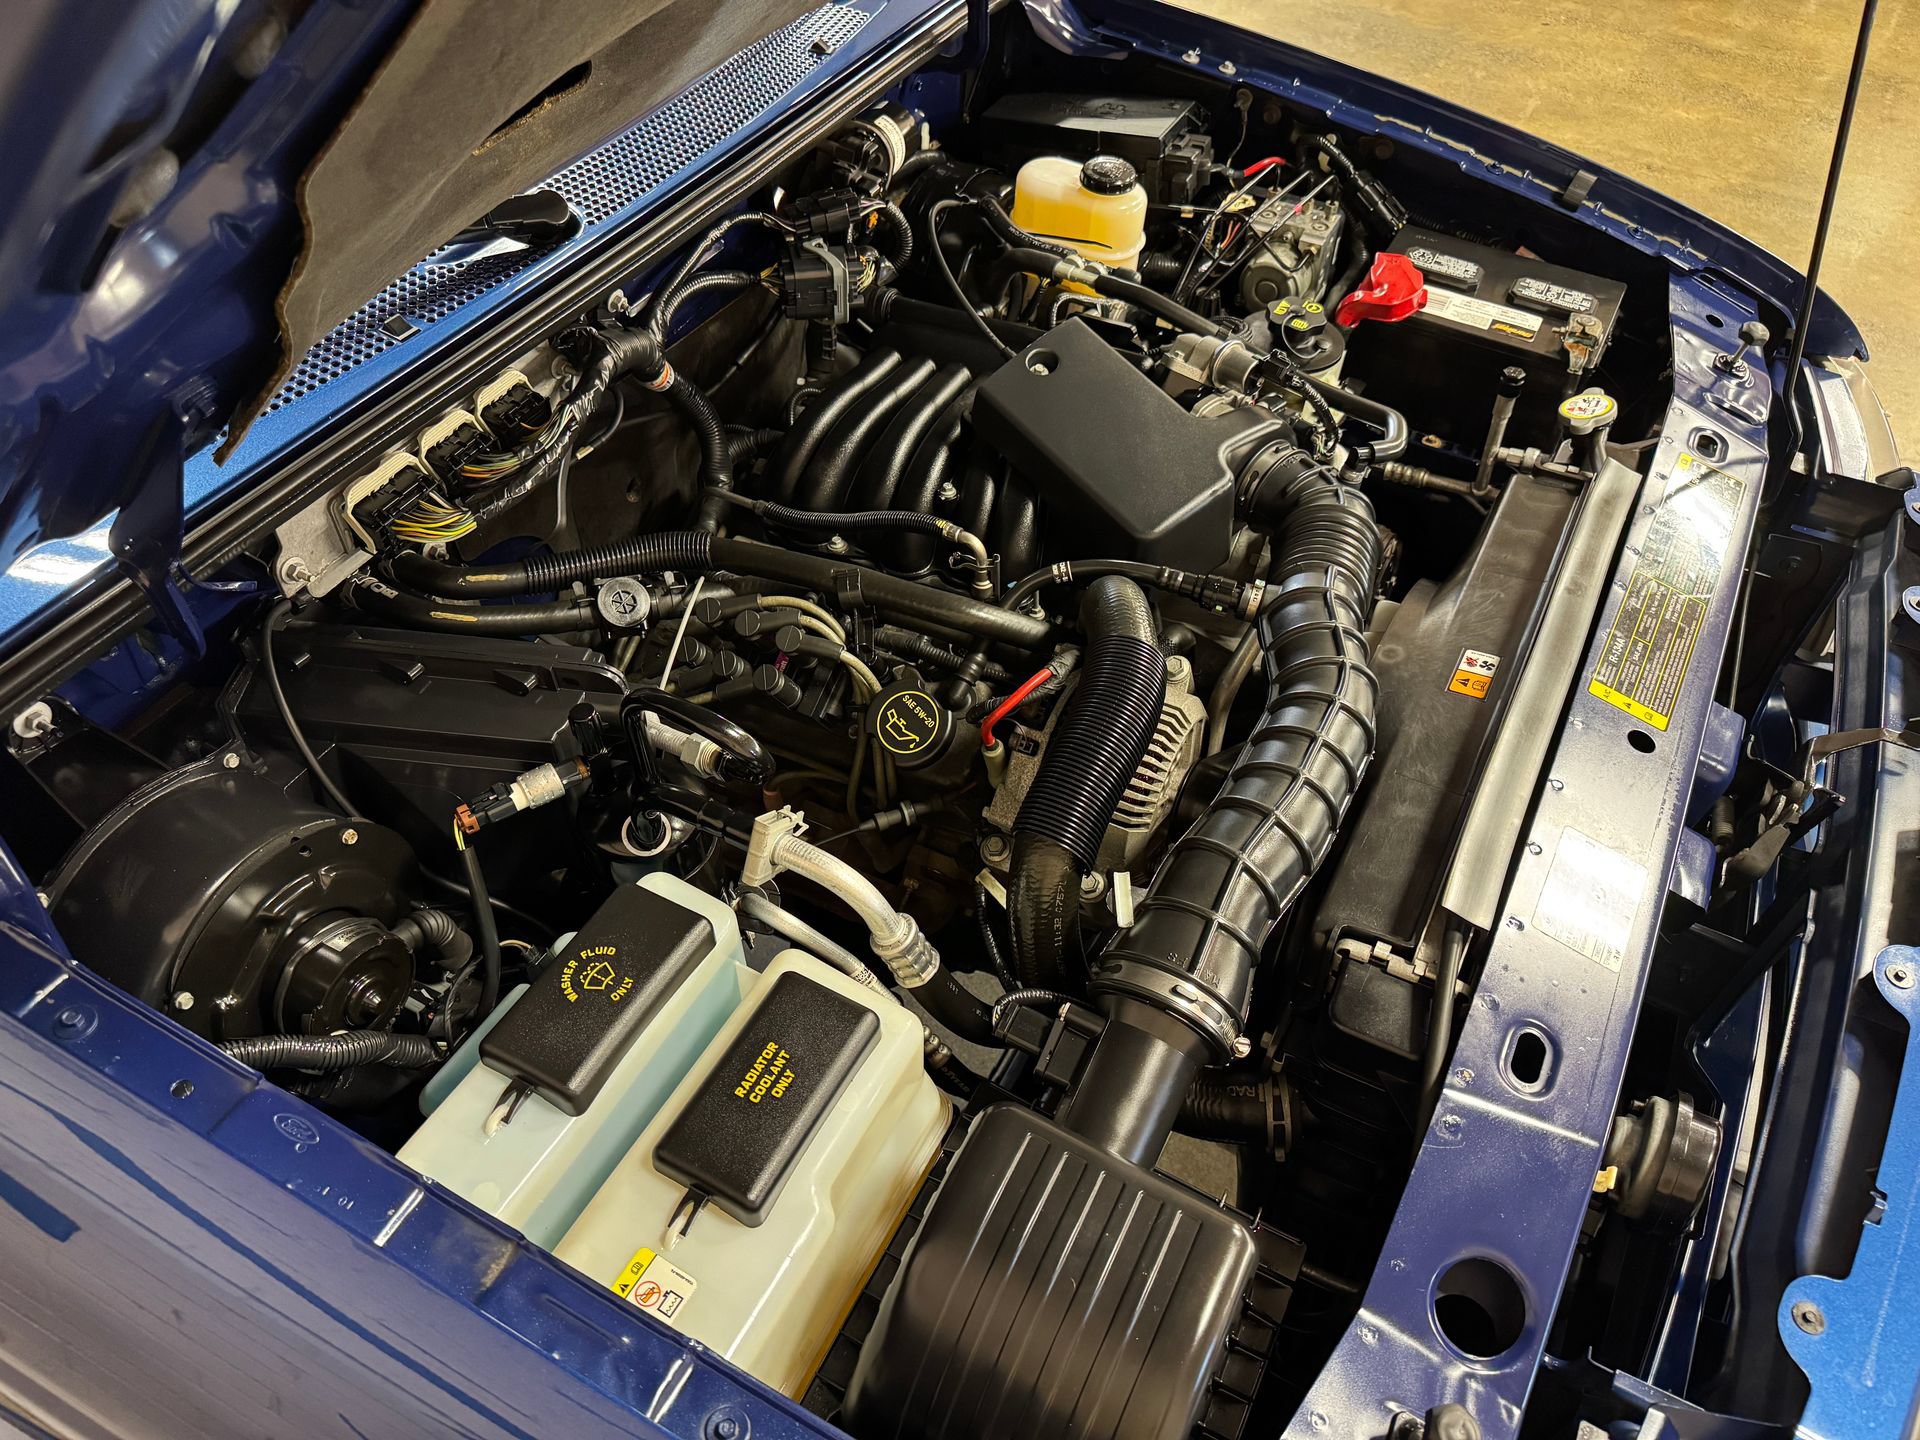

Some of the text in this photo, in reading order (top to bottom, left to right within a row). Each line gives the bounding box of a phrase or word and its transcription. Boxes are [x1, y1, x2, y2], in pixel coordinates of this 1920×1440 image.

[1608, 637, 1626, 664] R-134A
[902, 694, 936, 728] SAE 5W-20
[560, 946, 616, 1003] WASHER FLUID
[610, 976, 634, 1002] ONLY
[734, 1041, 780, 1099] RADIATOR
[748, 1049, 790, 1104] COOLANT
[771, 1068, 795, 1099] ONLY
